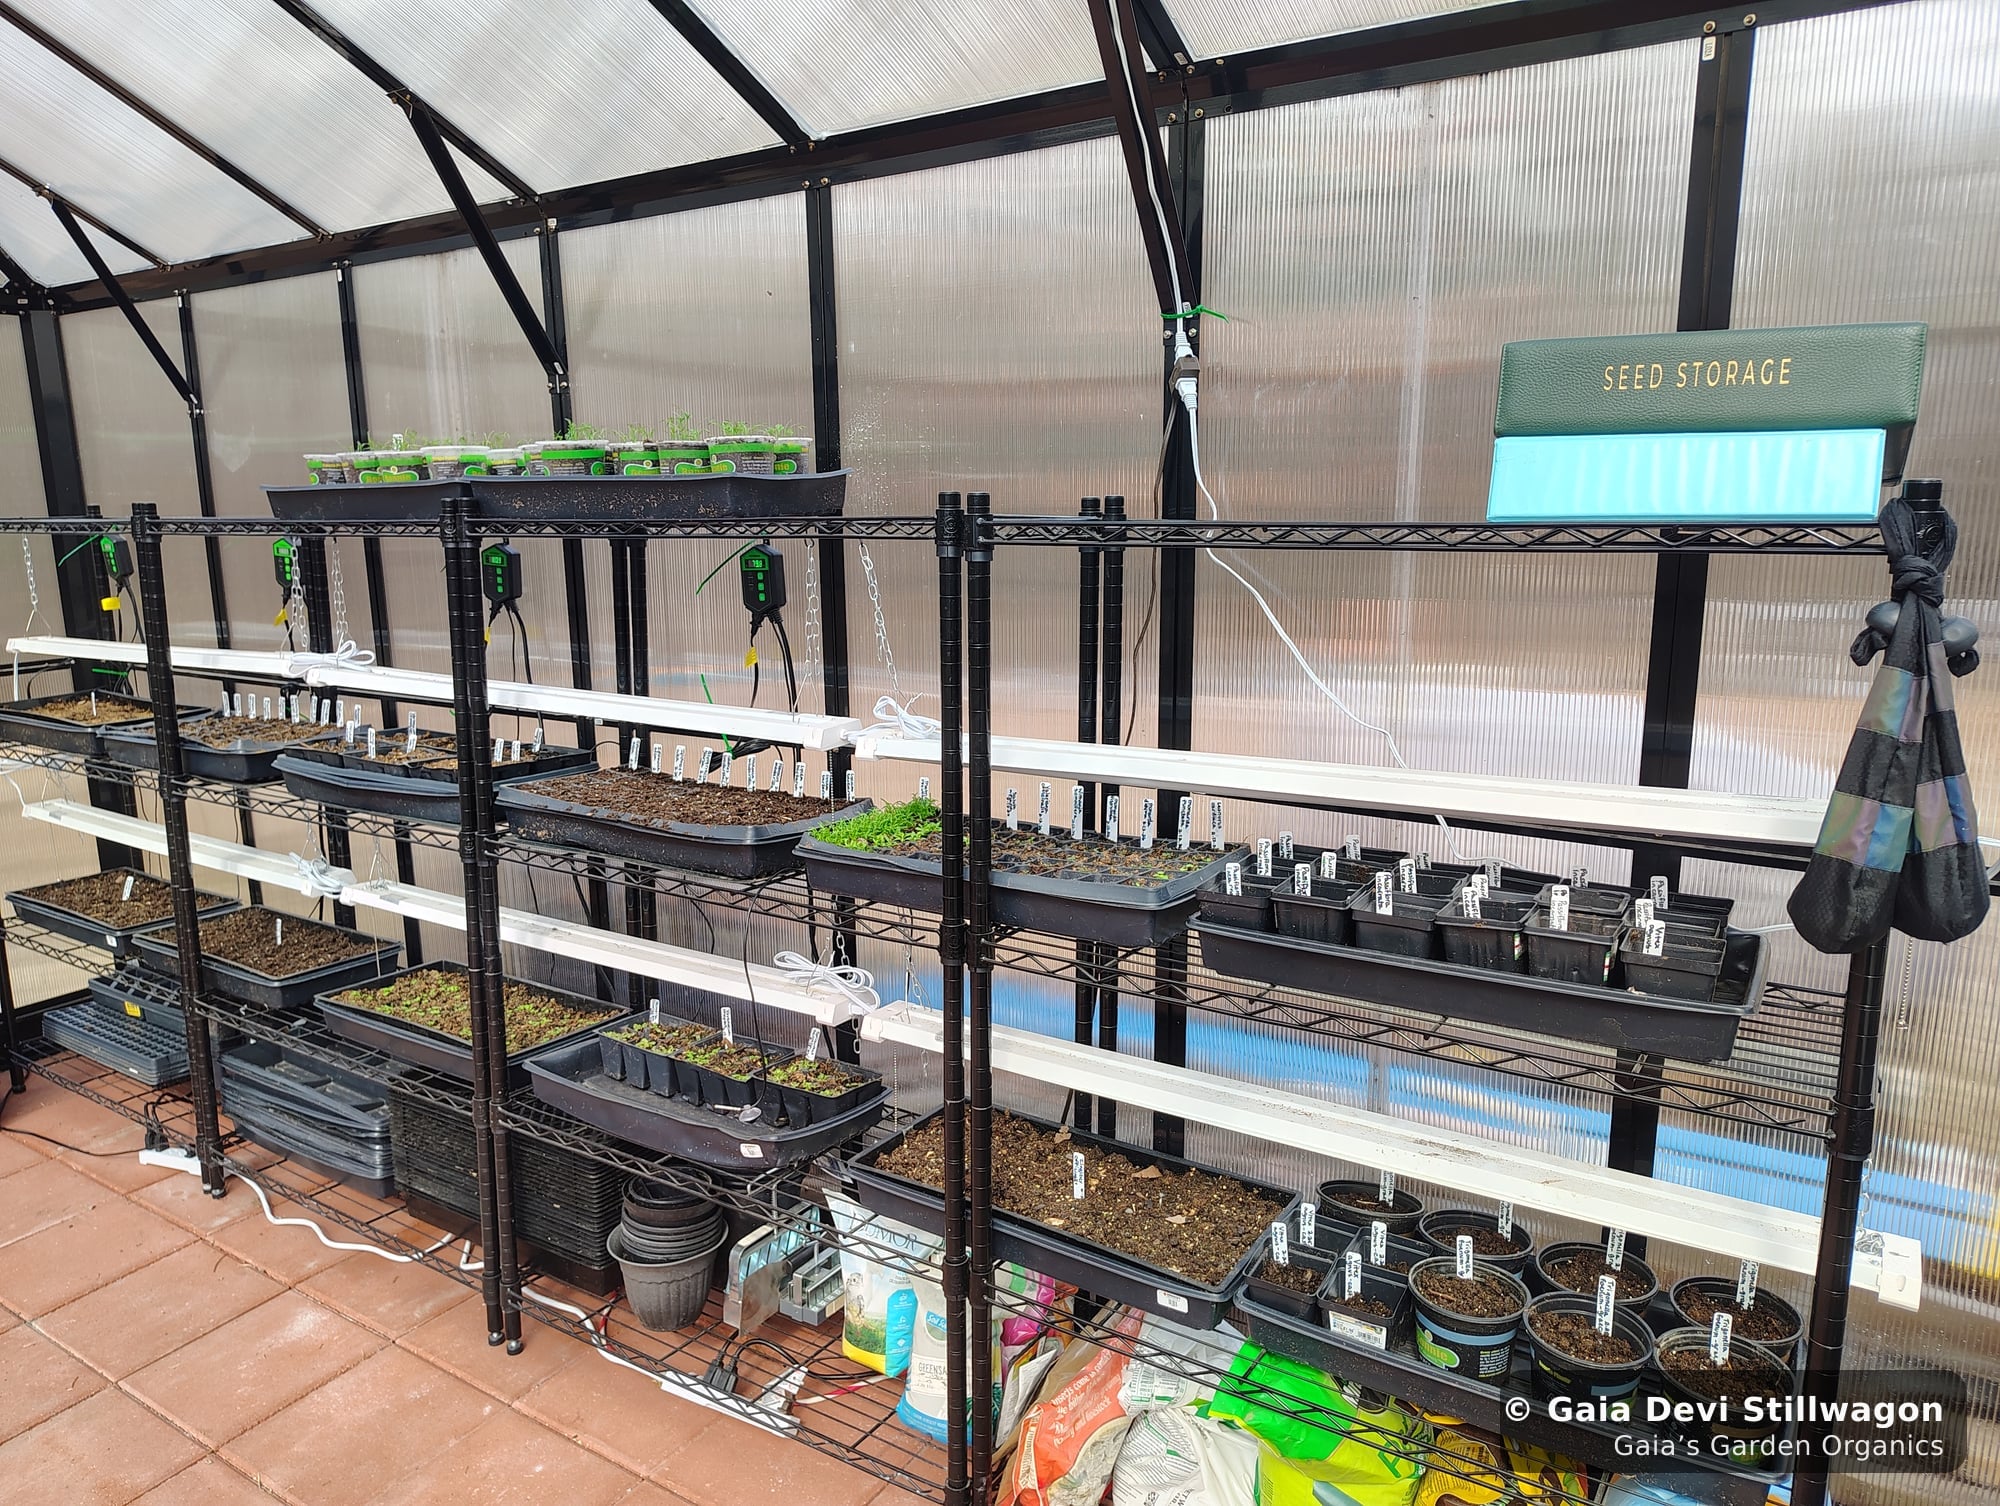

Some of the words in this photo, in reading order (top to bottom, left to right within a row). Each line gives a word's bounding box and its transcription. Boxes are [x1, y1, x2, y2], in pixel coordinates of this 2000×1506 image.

[1603, 363, 1663, 391] SEED
[1676, 357, 1792, 388] STORAGE
[918, 1362, 948, 1376] GREENSA
